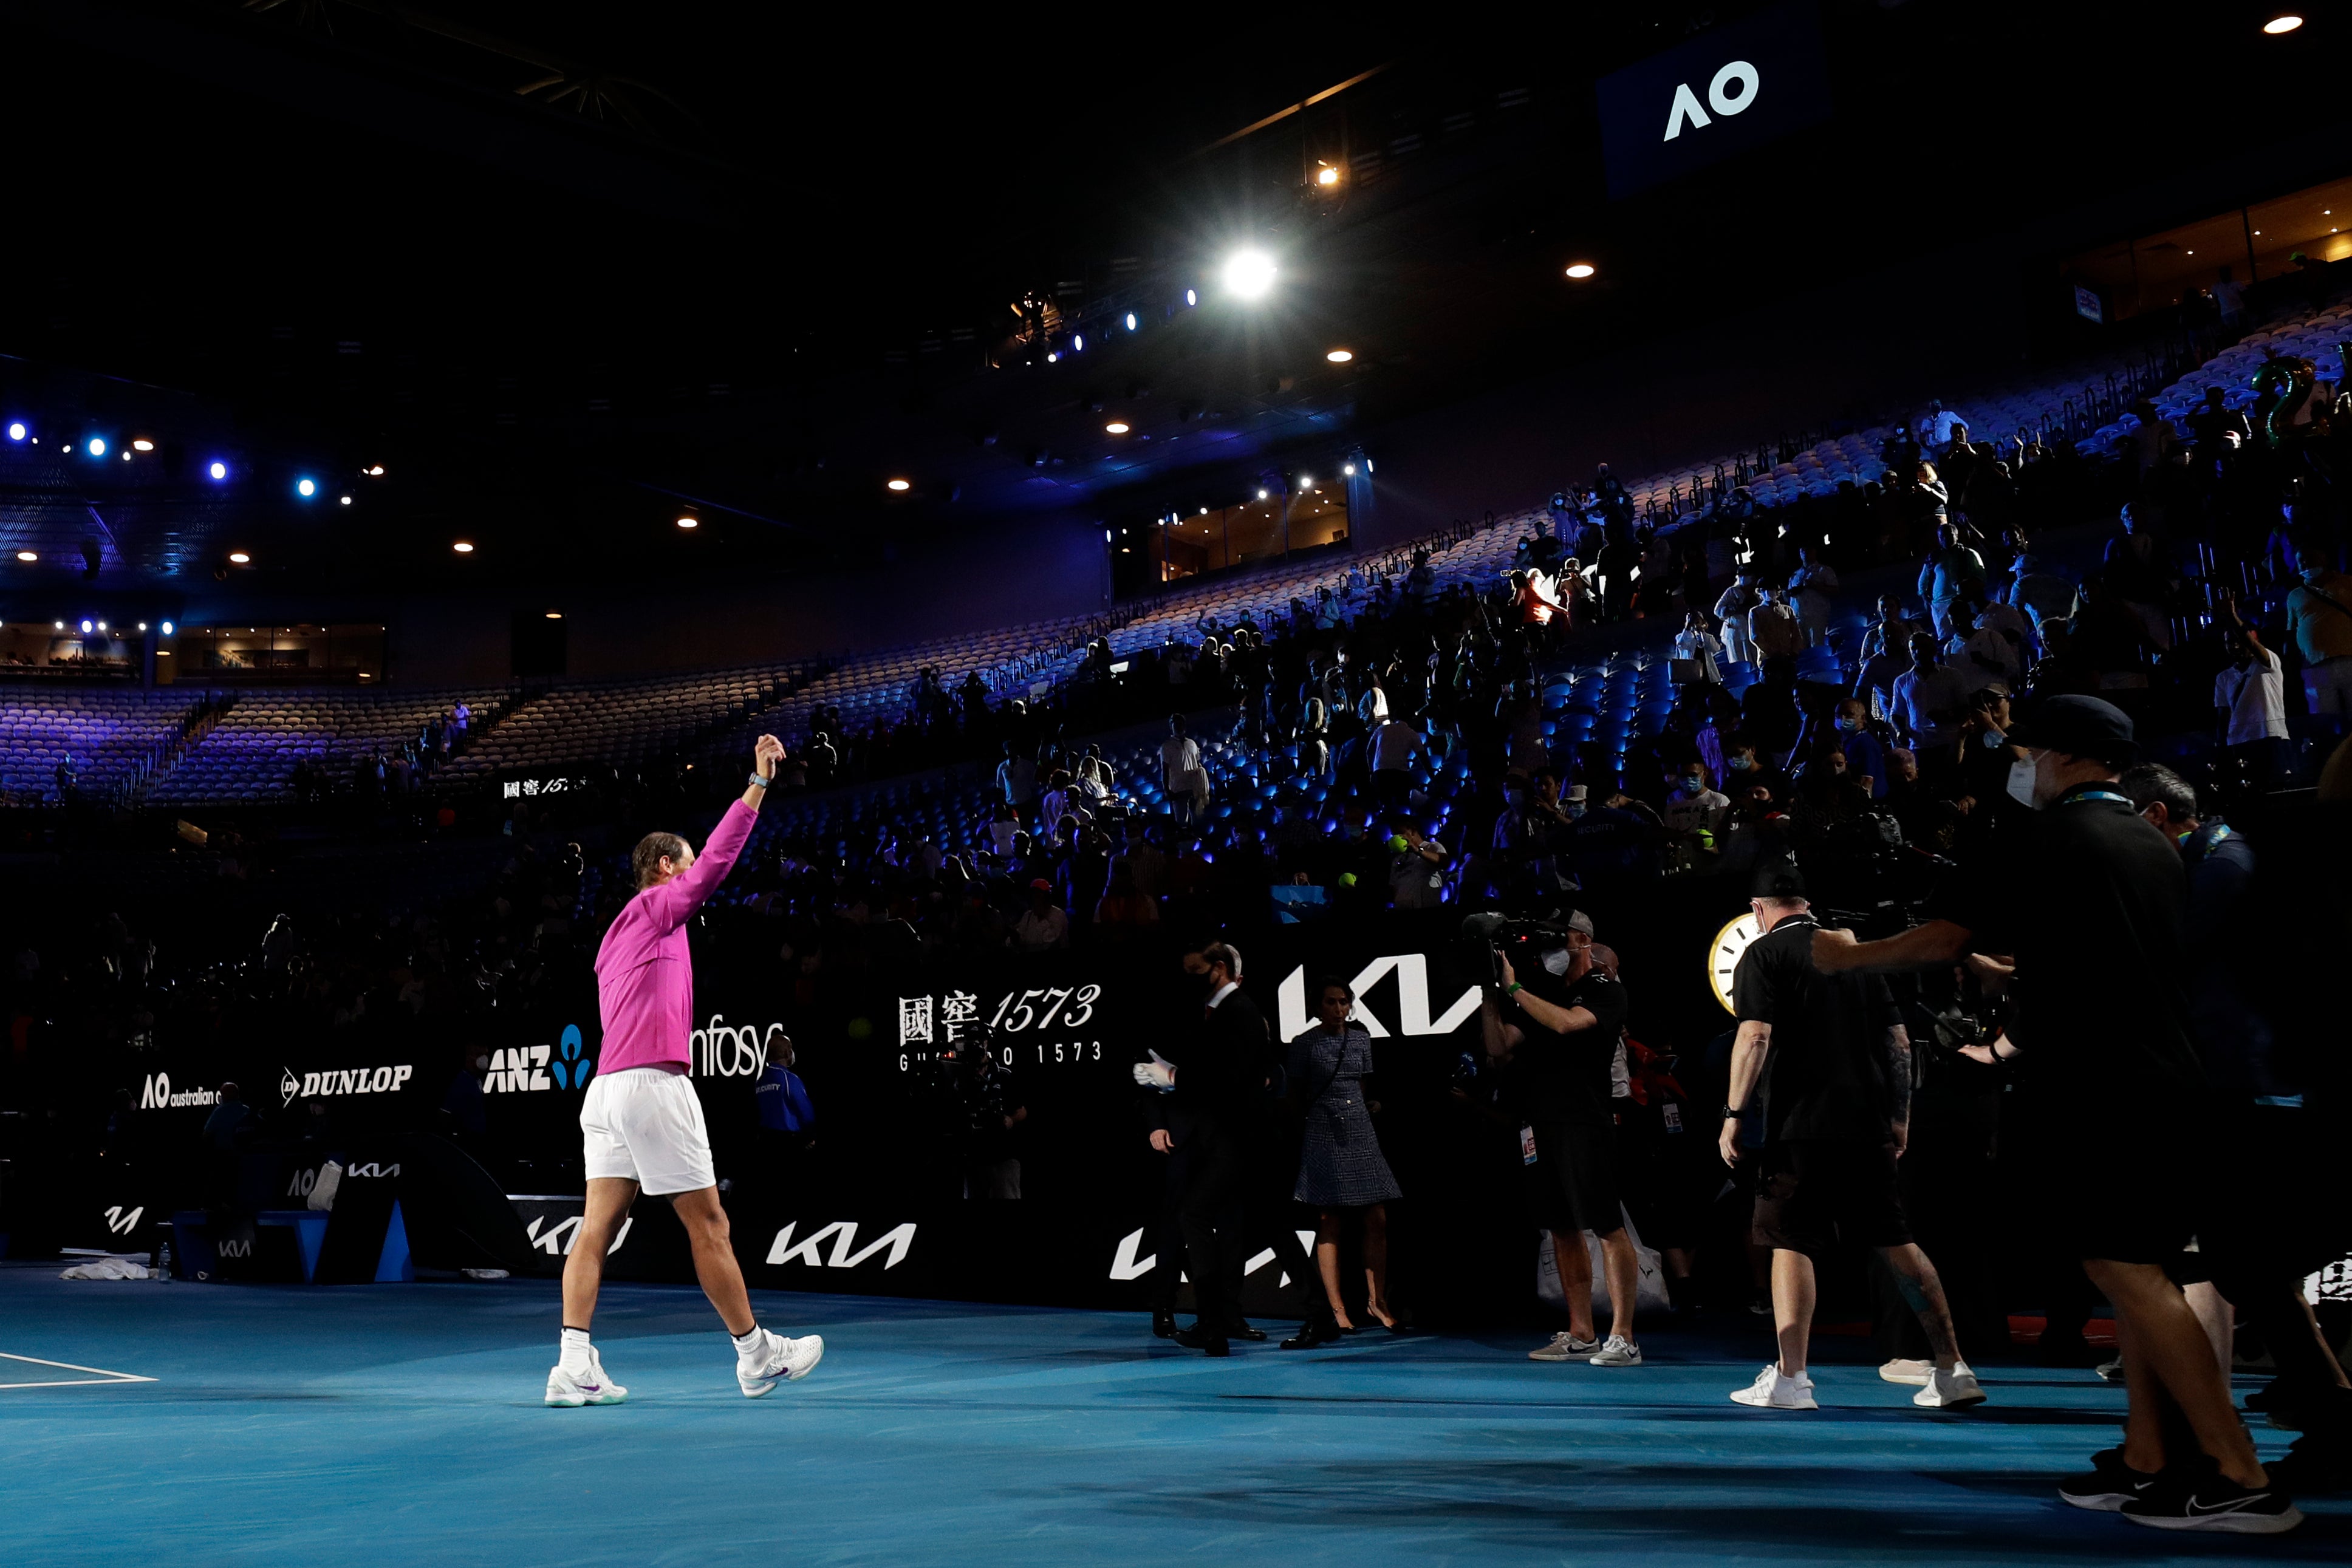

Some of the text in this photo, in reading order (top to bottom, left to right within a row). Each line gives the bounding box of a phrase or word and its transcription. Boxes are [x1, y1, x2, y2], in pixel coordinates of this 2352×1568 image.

[1663, 60, 1760, 142] AO
[990, 984, 1101, 1032] 1573
[482, 1045, 551, 1094] ANZ
[1038, 1041, 1101, 1064] 1573
[140, 1072, 170, 1110] AO
[170, 1086, 214, 1108] australian
[300, 1065, 412, 1098] DUNLOP
[348, 1162, 400, 1178] KIA
[219, 1239, 251, 1258] KIA
[765, 1221, 917, 1271] KIA
